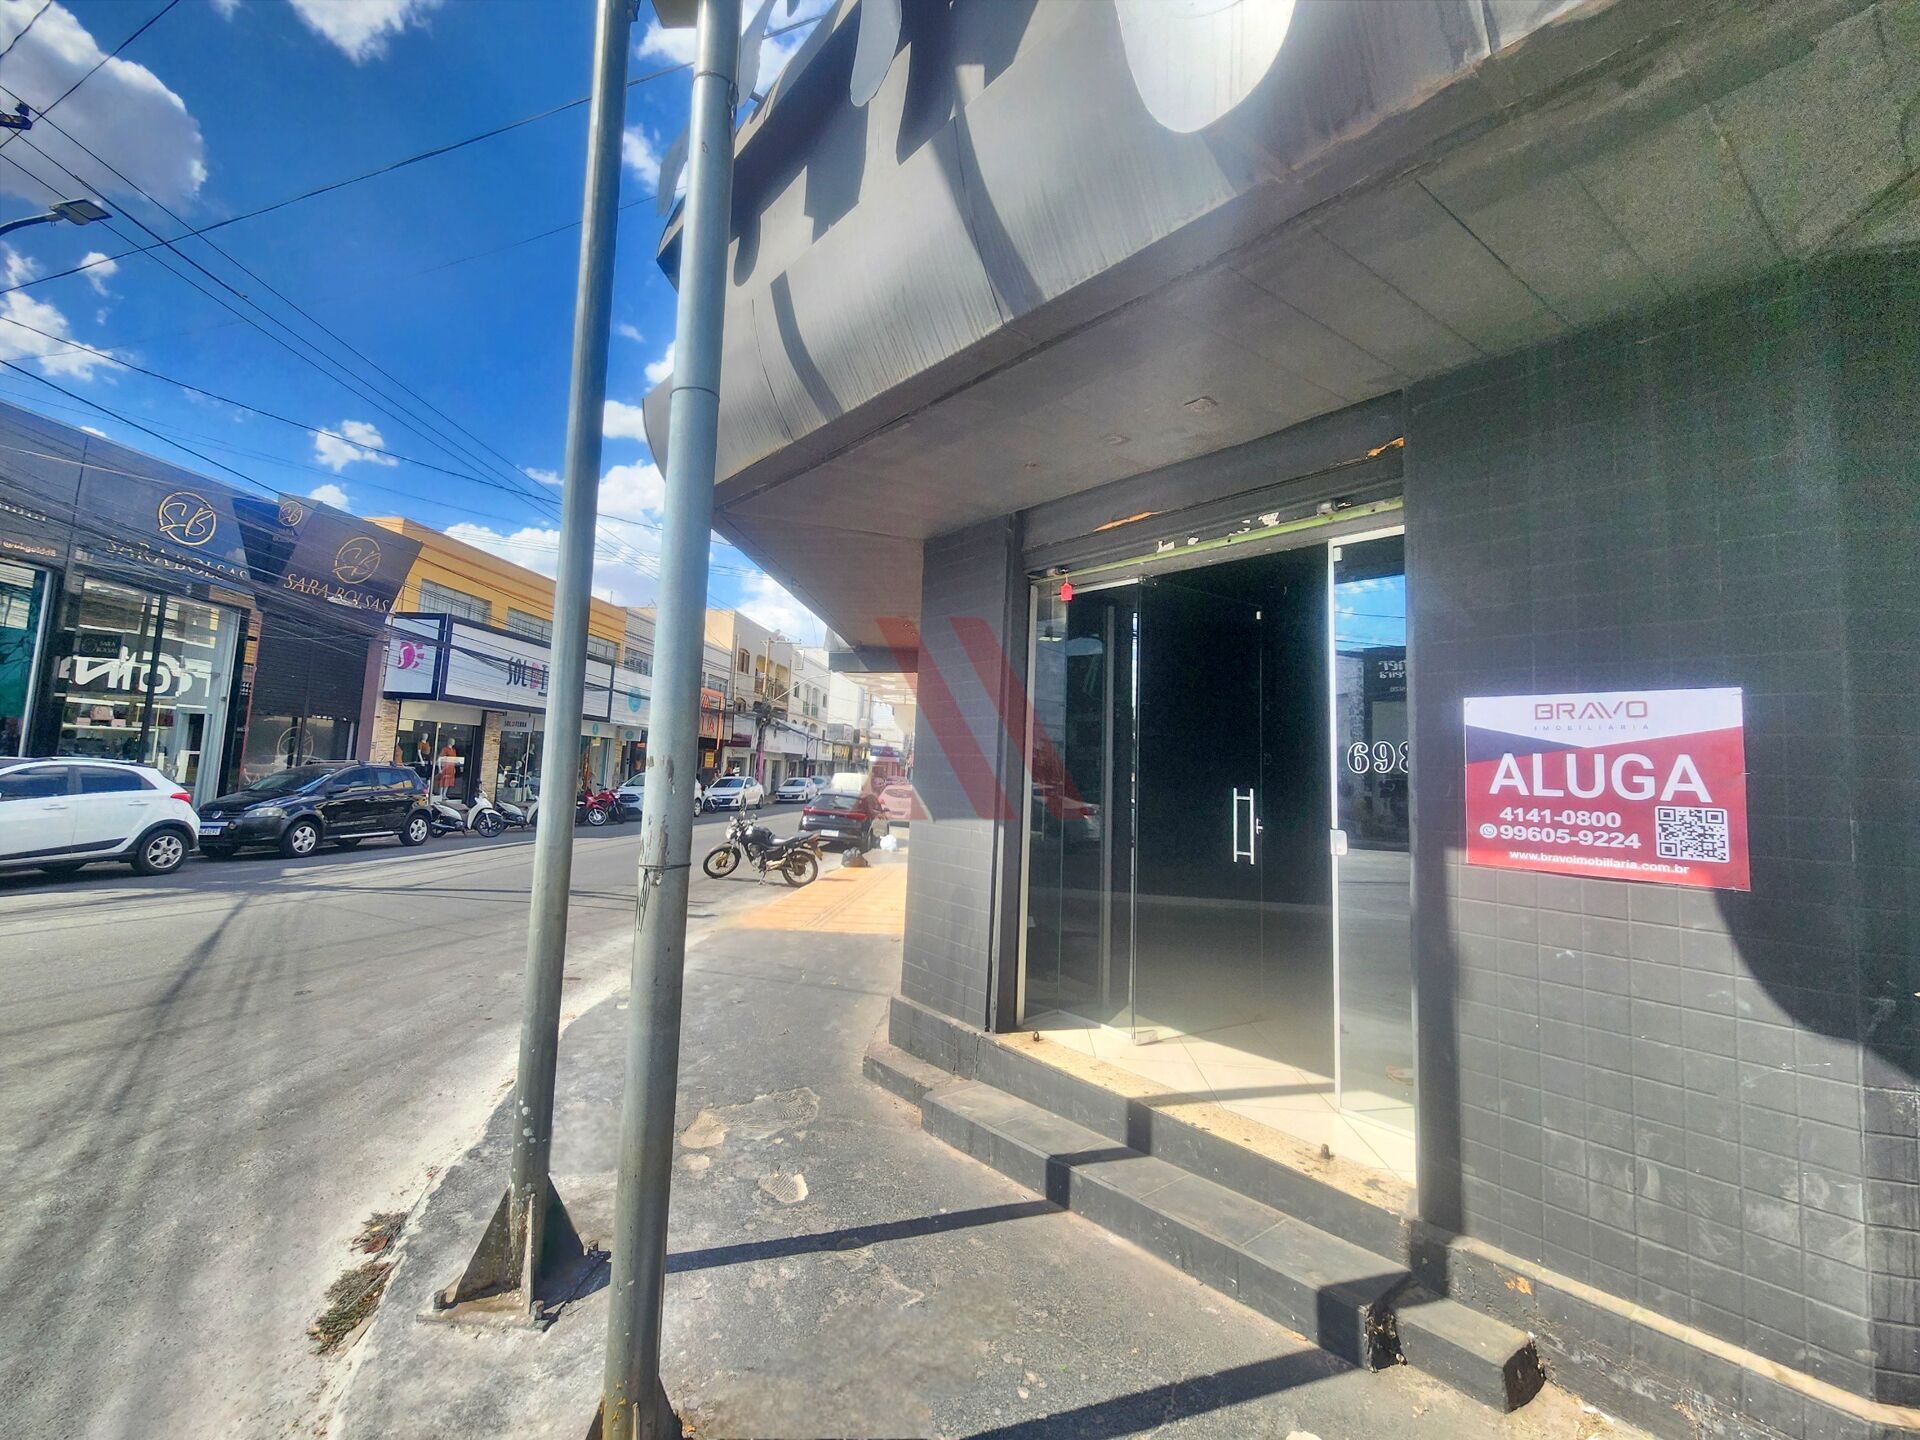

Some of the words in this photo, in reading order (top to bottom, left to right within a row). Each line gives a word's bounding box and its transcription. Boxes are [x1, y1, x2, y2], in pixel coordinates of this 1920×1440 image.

[283, 573, 329, 599] SARA
[1534, 700, 1648, 720] BRAVO
[1489, 753, 1713, 803] ALUGA
[1499, 806, 1622, 828] 4141-0800
[1500, 825, 1642, 849] 99605-9224
[1509, 850, 1690, 874] www.bravoimobiliaria.com.br
